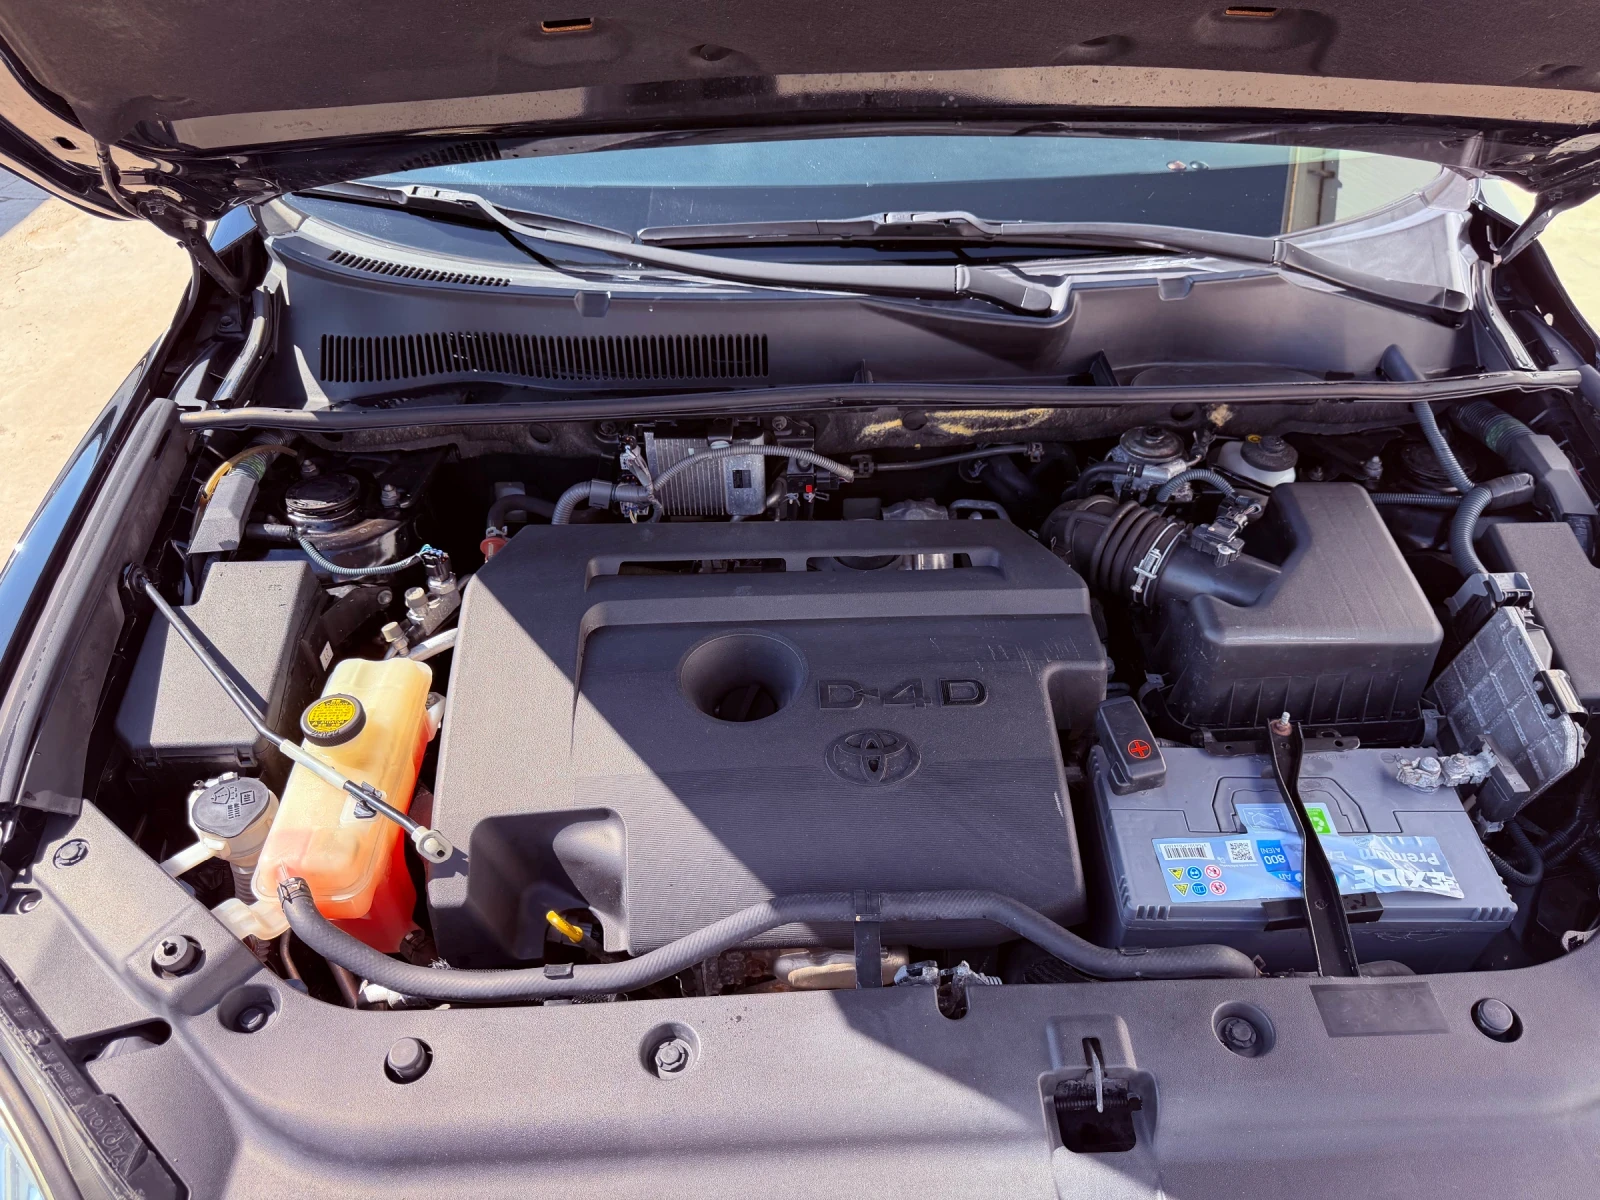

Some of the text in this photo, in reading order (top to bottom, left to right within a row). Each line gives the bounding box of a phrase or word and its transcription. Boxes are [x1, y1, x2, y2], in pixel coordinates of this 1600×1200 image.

[817, 678, 988, 710] D-4D
[1263, 854, 1286, 865] 800
[1359, 848, 1440, 865] Premium
[1353, 865, 1452, 892] EXIDE
[84, 1106, 129, 1171] TOYOTA
